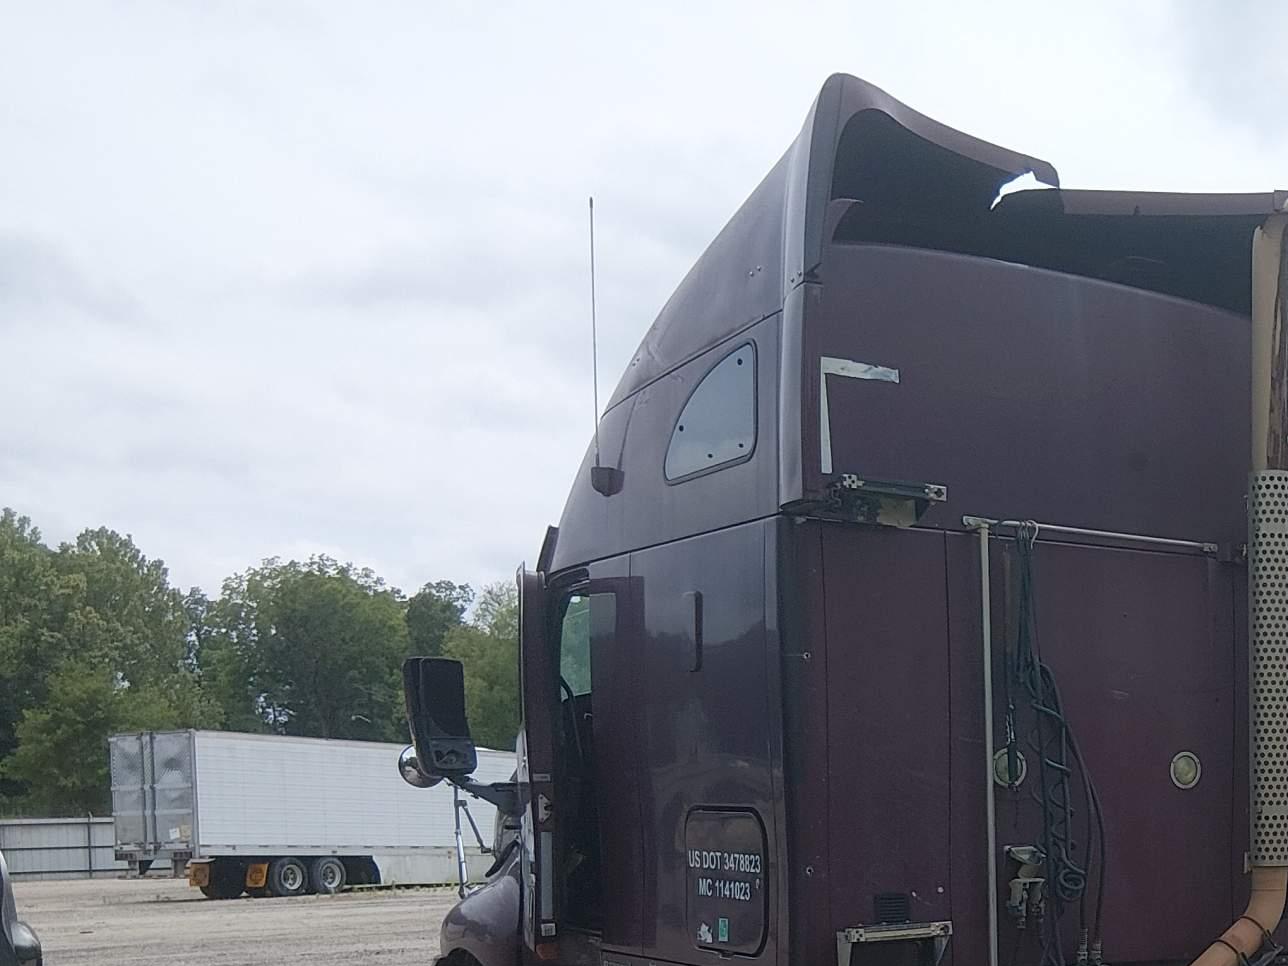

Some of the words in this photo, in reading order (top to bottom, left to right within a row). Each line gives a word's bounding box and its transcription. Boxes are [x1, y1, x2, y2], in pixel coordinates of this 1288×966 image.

[688, 849, 701, 868] US
[702, 851, 722, 870] DOT
[724, 853, 761, 874] 3478823
[698, 878, 713, 896] MC
[714, 879, 751, 901] 1141023
